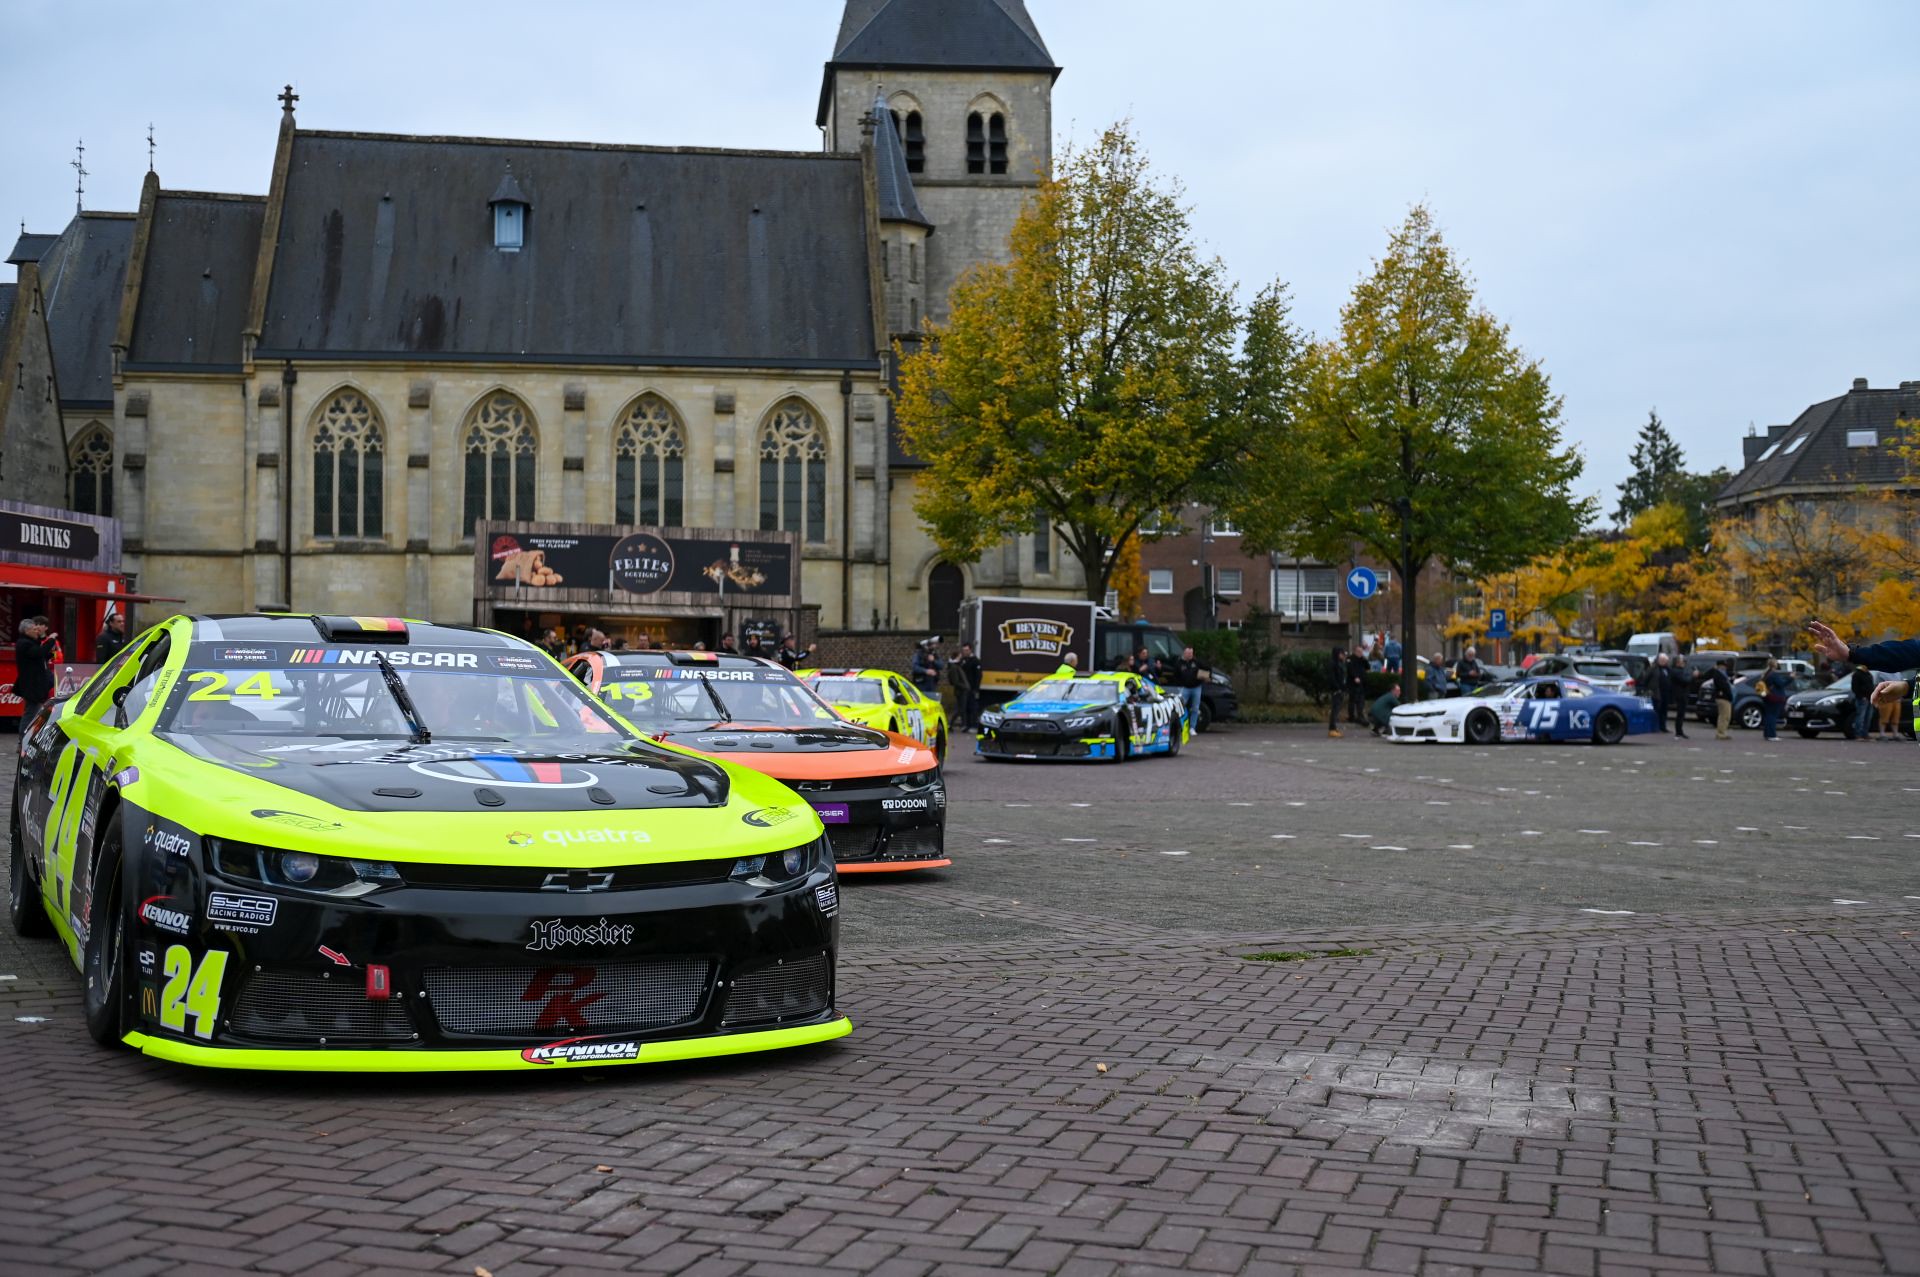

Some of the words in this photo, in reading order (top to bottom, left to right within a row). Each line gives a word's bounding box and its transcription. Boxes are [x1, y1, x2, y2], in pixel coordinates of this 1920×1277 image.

[20, 522, 71, 549] DRINKS
[614, 557, 670, 573] FRITES
[1491, 611, 1504, 627] P
[1016, 623, 1059, 635] BEVERS
[1015, 639, 1058, 651] BEVERS
[338, 649, 479, 668] NASCAR
[680, 669, 754, 681] NASCAR
[187, 671, 281, 701] 24
[600, 682, 653, 700] 13
[1529, 701, 1559, 728] 75
[895, 799, 928, 808] DODONI
[154, 830, 191, 857] quatra
[543, 826, 652, 847] quatra
[211, 896, 273, 911] SYCO
[142, 903, 190, 930] KENNOL
[210, 909, 237, 918] RACING
[240, 912, 271, 922] RADIOS
[214, 924, 259, 934] WWW.SYCO.EU
[525, 917, 635, 951] Hoosier
[160, 944, 230, 1040] 24
[531, 1042, 639, 1059] KENNOL
